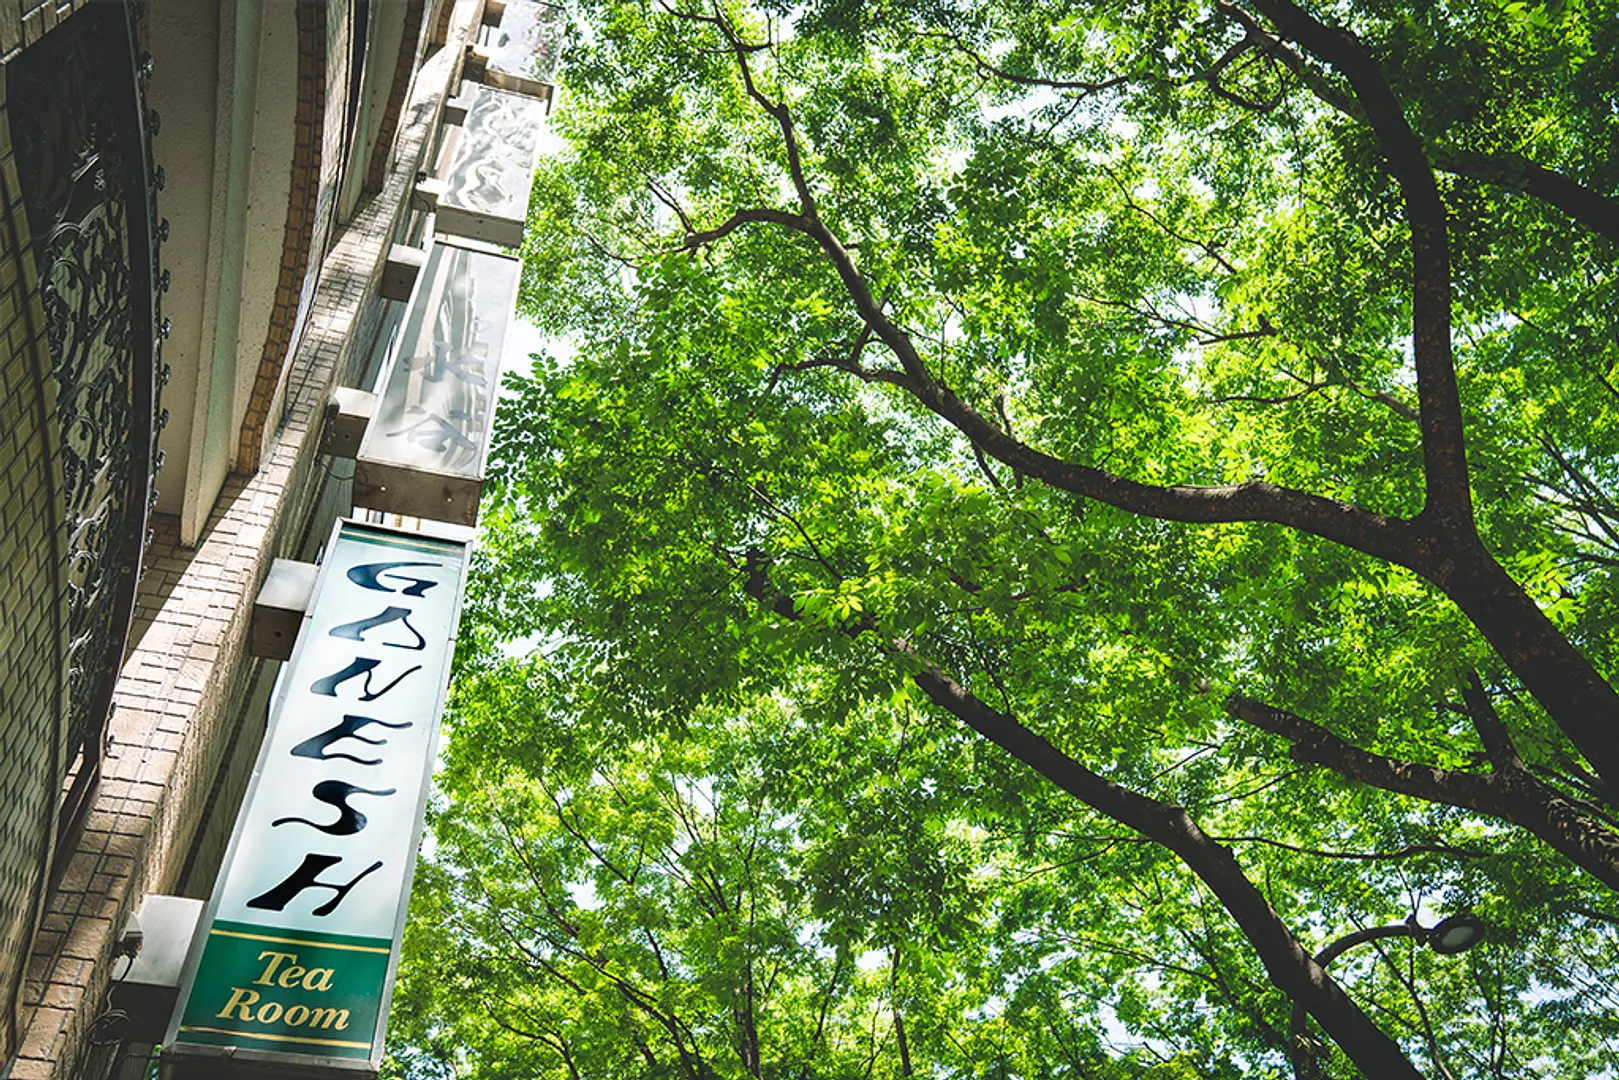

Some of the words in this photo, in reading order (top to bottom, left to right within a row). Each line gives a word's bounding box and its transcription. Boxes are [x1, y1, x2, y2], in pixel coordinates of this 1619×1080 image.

[246, 560, 444, 916] GANESH
[252, 950, 335, 992] Tea
[215, 986, 350, 1031] Room
